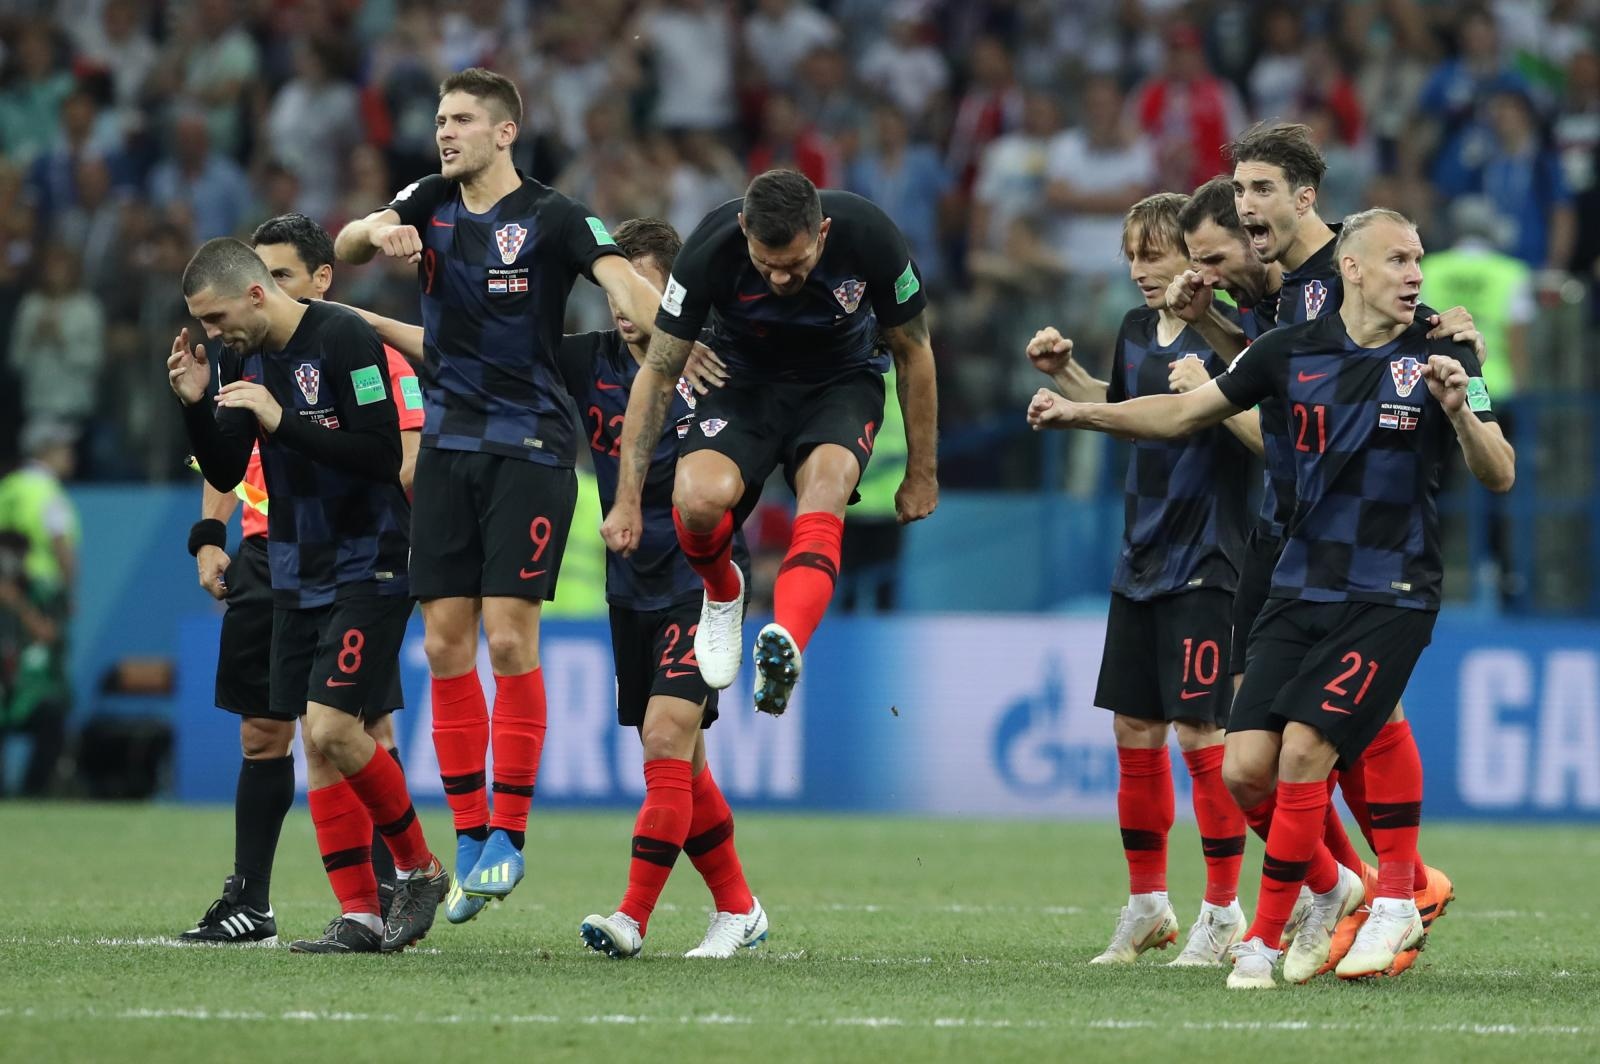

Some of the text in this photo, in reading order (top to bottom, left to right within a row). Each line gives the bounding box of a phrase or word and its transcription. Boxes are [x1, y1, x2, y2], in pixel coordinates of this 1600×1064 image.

[588, 406, 625, 457] 22
[1293, 403, 1326, 455] 21
[529, 516, 551, 562] 9
[338, 629, 365, 674] 8
[659, 623, 701, 667] 22
[1182, 638, 1219, 686] 10
[1323, 651, 1380, 705] 21
